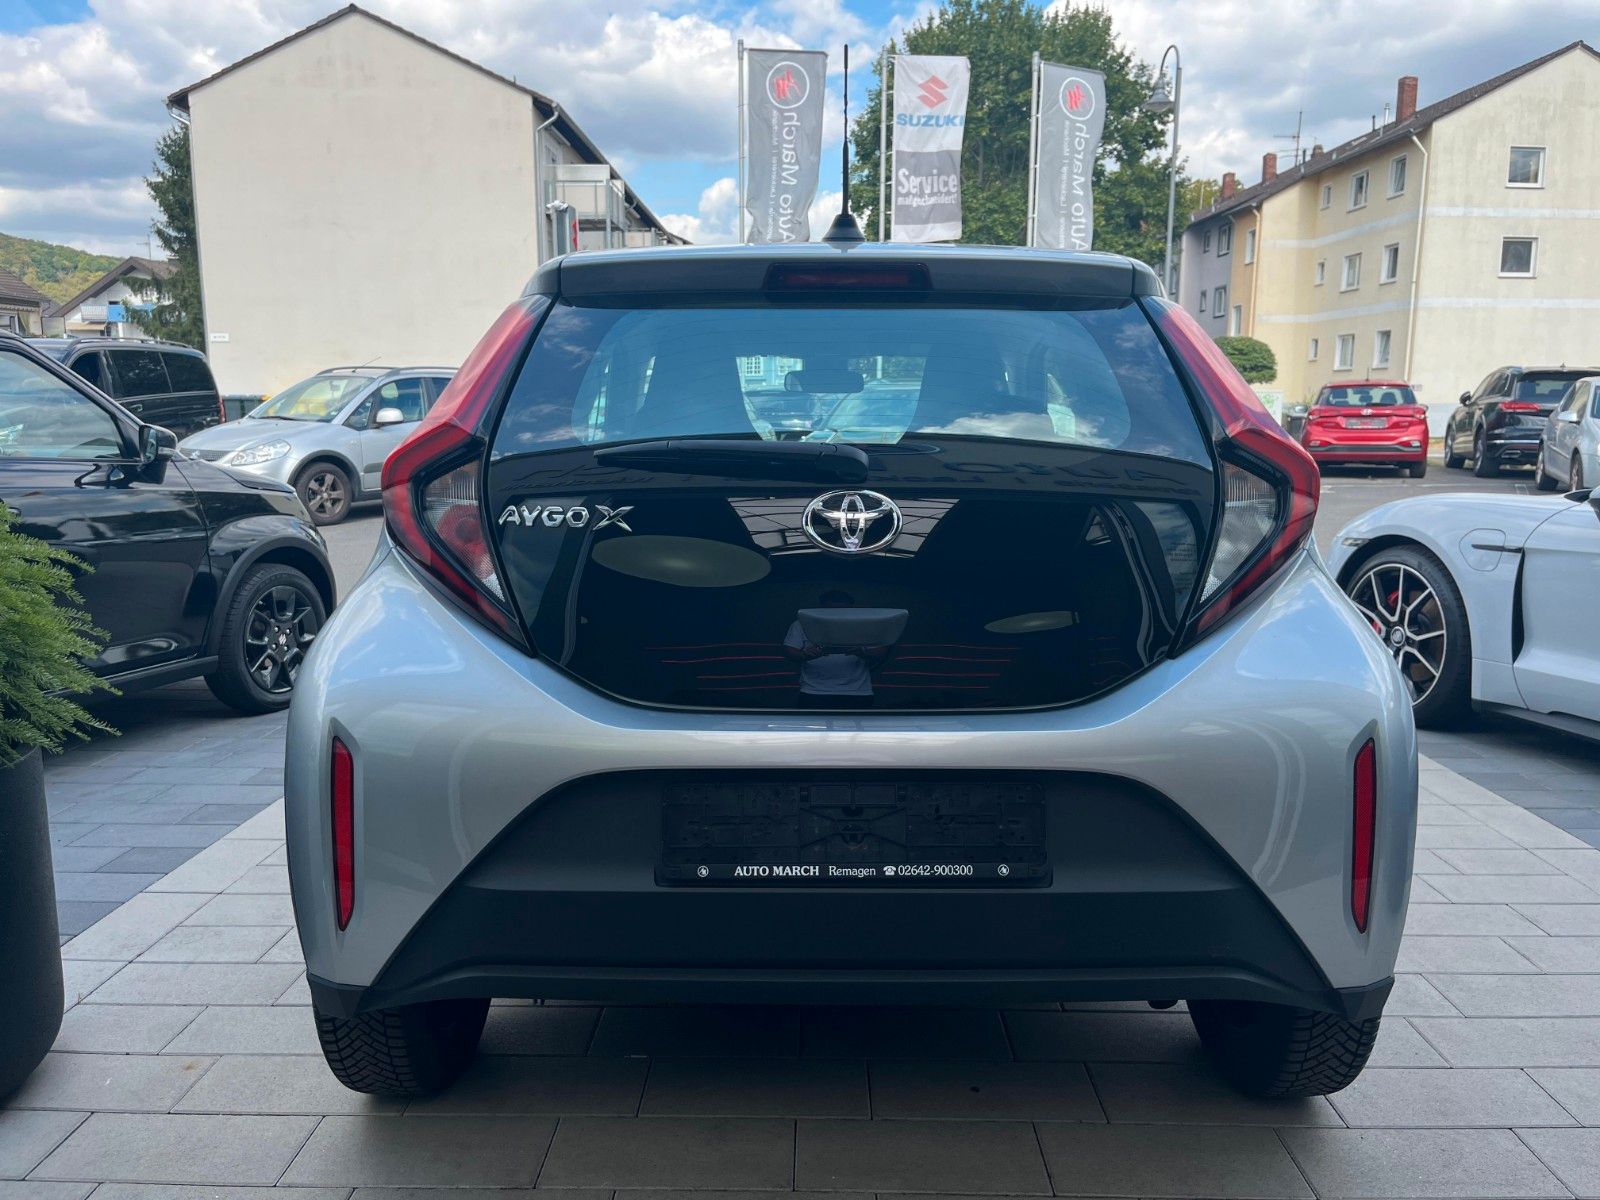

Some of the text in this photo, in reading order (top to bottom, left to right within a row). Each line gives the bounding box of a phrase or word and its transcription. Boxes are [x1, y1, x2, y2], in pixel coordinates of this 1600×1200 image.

[896, 113, 966, 128] SUZUKI
[897, 168, 958, 194] Service
[498, 504, 635, 532] AYGO X
[734, 865, 973, 878] AUTO MARCH Remagen 02642-900300
